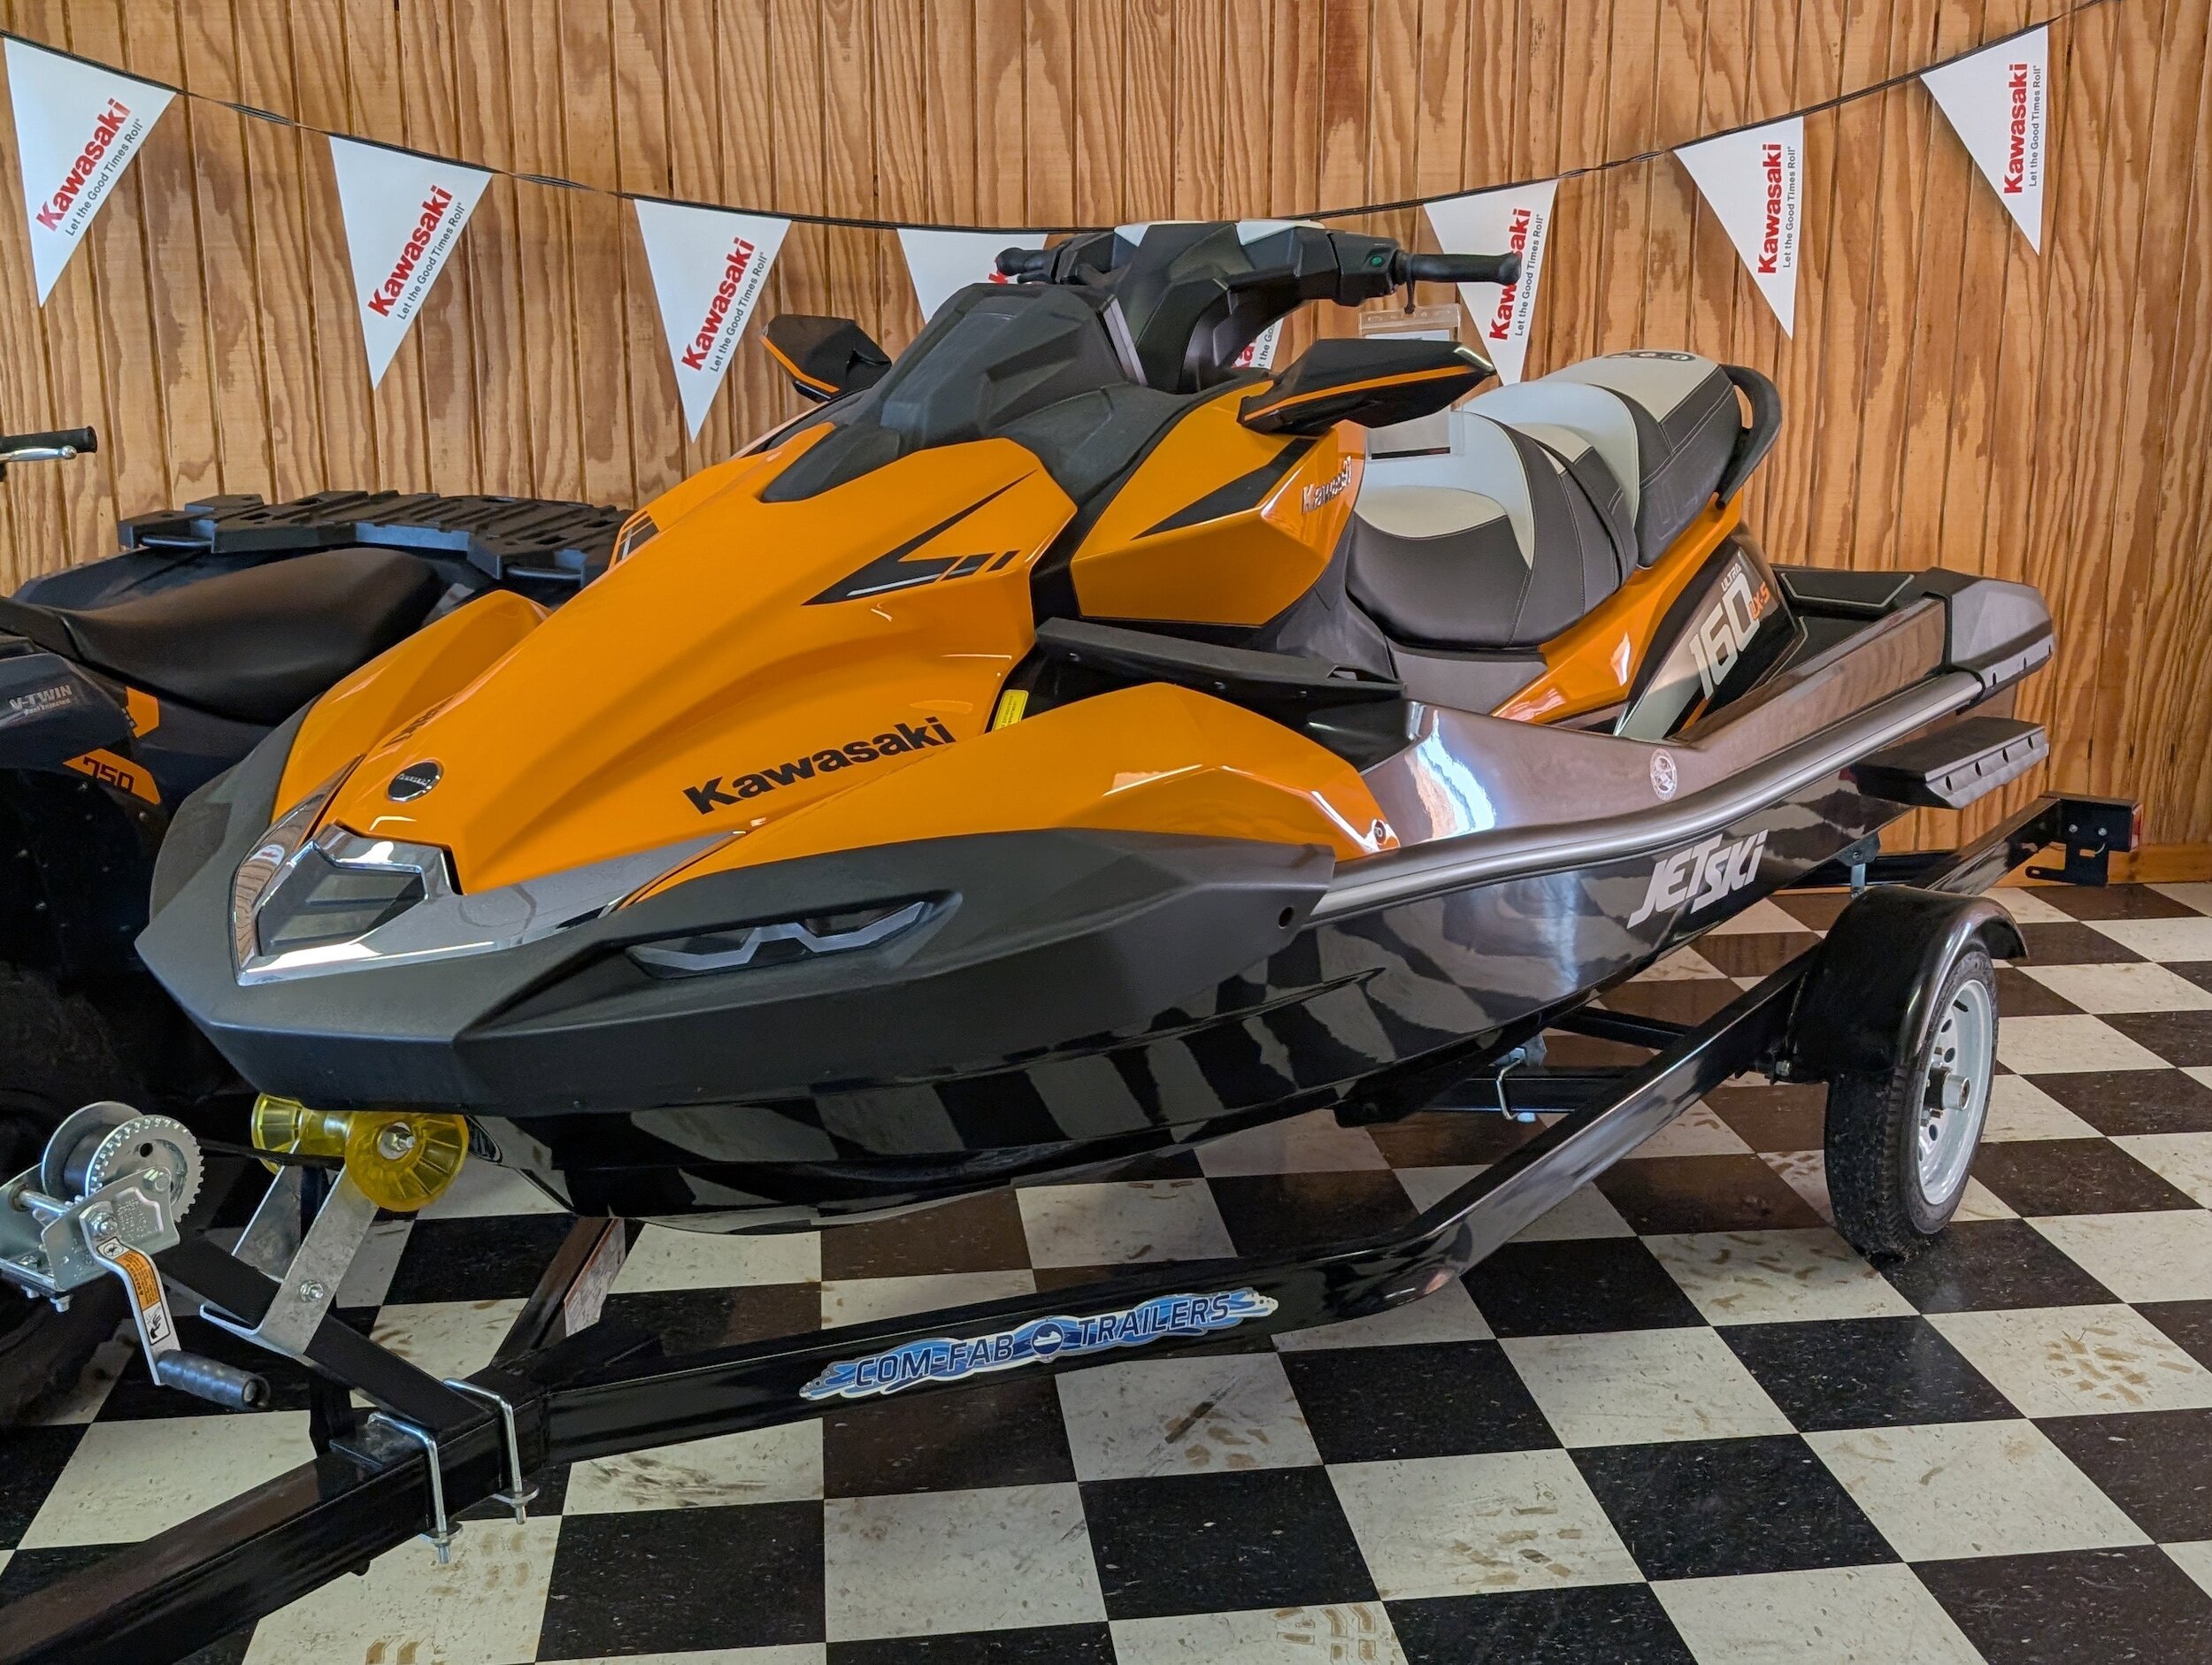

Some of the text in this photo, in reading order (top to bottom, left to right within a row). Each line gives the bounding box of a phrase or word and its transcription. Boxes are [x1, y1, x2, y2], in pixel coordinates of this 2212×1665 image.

[2032, 90, 2040, 120] Times
[2003, 64, 2028, 194] Kawasaki
[2031, 123, 2039, 150] Good
[36, 97, 132, 232] Kawasaki
[2030, 151, 2039, 168] the
[65, 219, 81, 237] Let
[76, 201, 92, 219] the
[88, 173, 110, 201] Good
[104, 143, 129, 173] Times
[1787, 171, 1796, 202] Times
[2029, 171, 2038, 187] Let
[1757, 144, 1782, 273] Kawasaki
[1786, 203, 1795, 231] Good
[367, 184, 453, 318] Kawasaki
[1527, 240, 1540, 270] Times
[396, 303, 411, 320] Let
[407, 286, 422, 303] the
[417, 257, 437, 285] Good
[431, 227, 454, 257] Times
[1489, 209, 1532, 341] Kawaki
[1522, 272, 1534, 299] Good
[680, 236, 756, 372] Kawasaki
[1519, 302, 1529, 318] the
[710, 355, 724, 372] Let
[719, 337, 733, 355] the
[726, 308, 744, 336] Good
[738, 277, 758, 308] Times
[1515, 320, 1525, 337] Let
[1260, 344, 1271, 360] the
[1721, 563, 1742, 592] ULTRA
[1688, 572, 1761, 701] 160
[9, 685, 72, 710] V-TWIN
[82, 756, 134, 793] 750
[682, 716, 957, 815] Kawasaki
[855, 1294, 1231, 1389] COM-FAB TRAILERS
